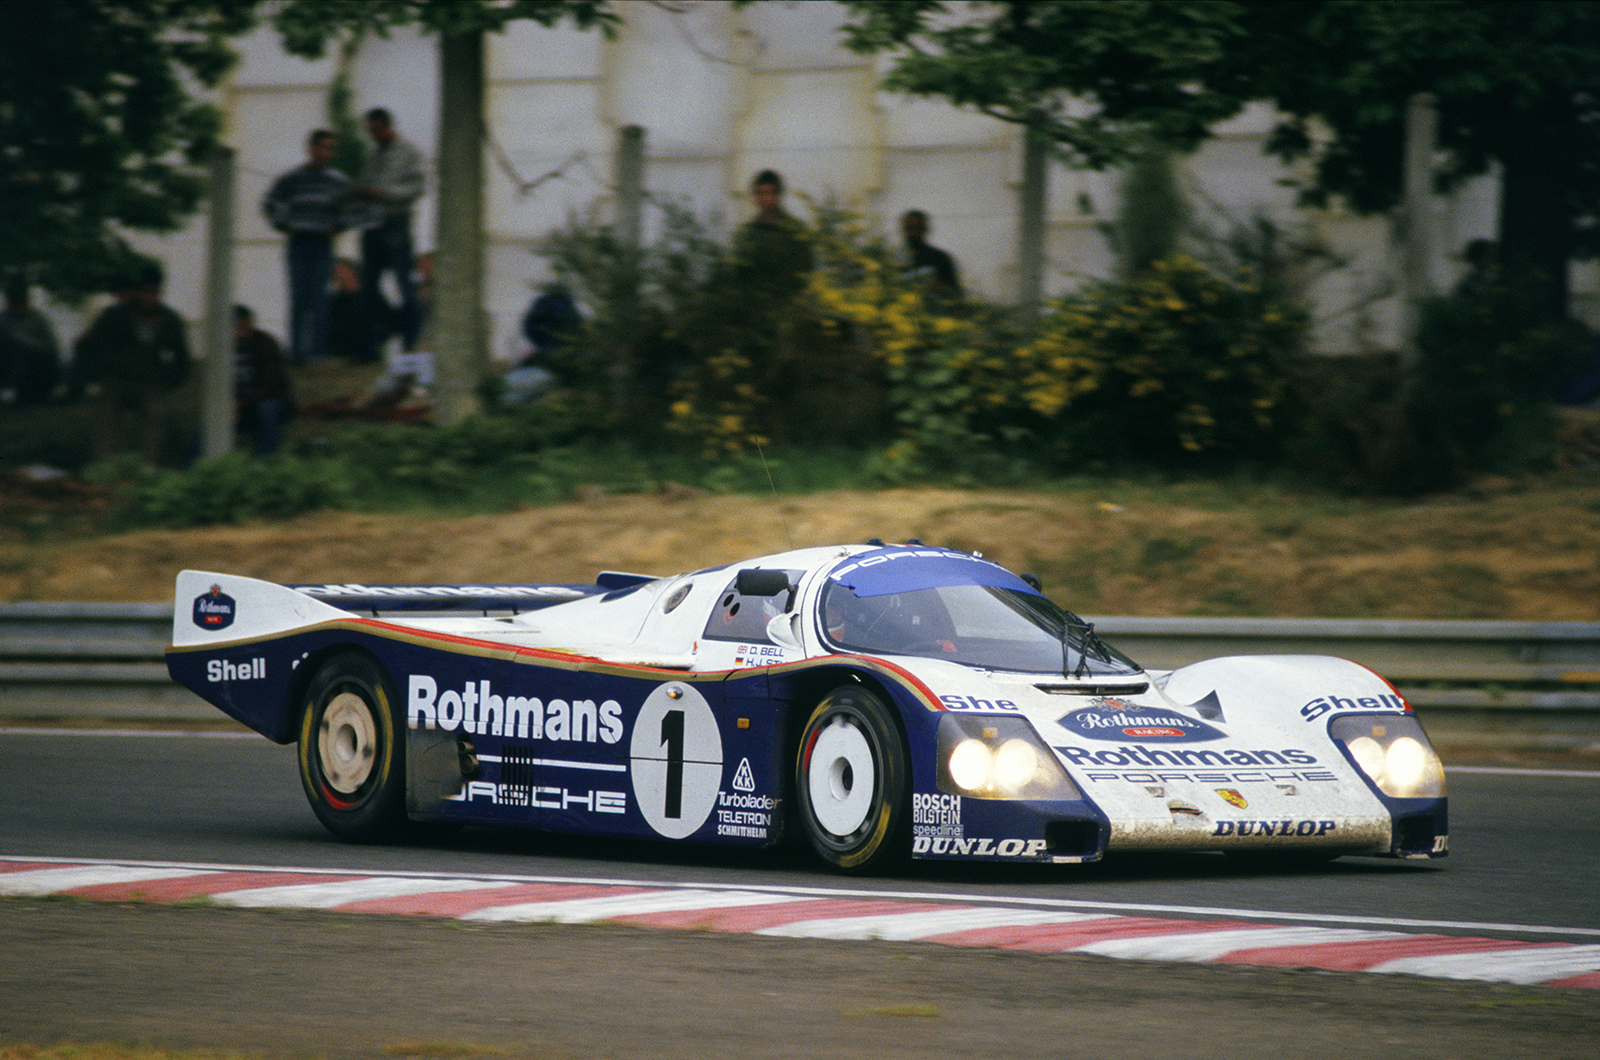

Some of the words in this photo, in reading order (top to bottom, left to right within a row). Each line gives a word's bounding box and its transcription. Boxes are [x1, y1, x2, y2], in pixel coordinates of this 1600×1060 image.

[760, 647, 784, 657] BELL
[207, 658, 265, 682] Shell
[408, 675, 623, 744] Rothmans
[940, 695, 1019, 710] She
[1300, 694, 1405, 722] Shell
[1076, 712, 1200, 729] Rothmans
[660, 710, 684, 818] 1
[1052, 745, 1317, 766] Rothmans
[1086, 772, 1338, 783] PORSCHE
[719, 791, 782, 810] Turbolader
[913, 793, 961, 810] BOSCH
[717, 810, 771, 826] TELETRON
[913, 809, 961, 824] BILSTEIN
[913, 824, 961, 837] speedline
[1212, 820, 1336, 836] DUNLOP
[913, 836, 1047, 857] DUNLOP
